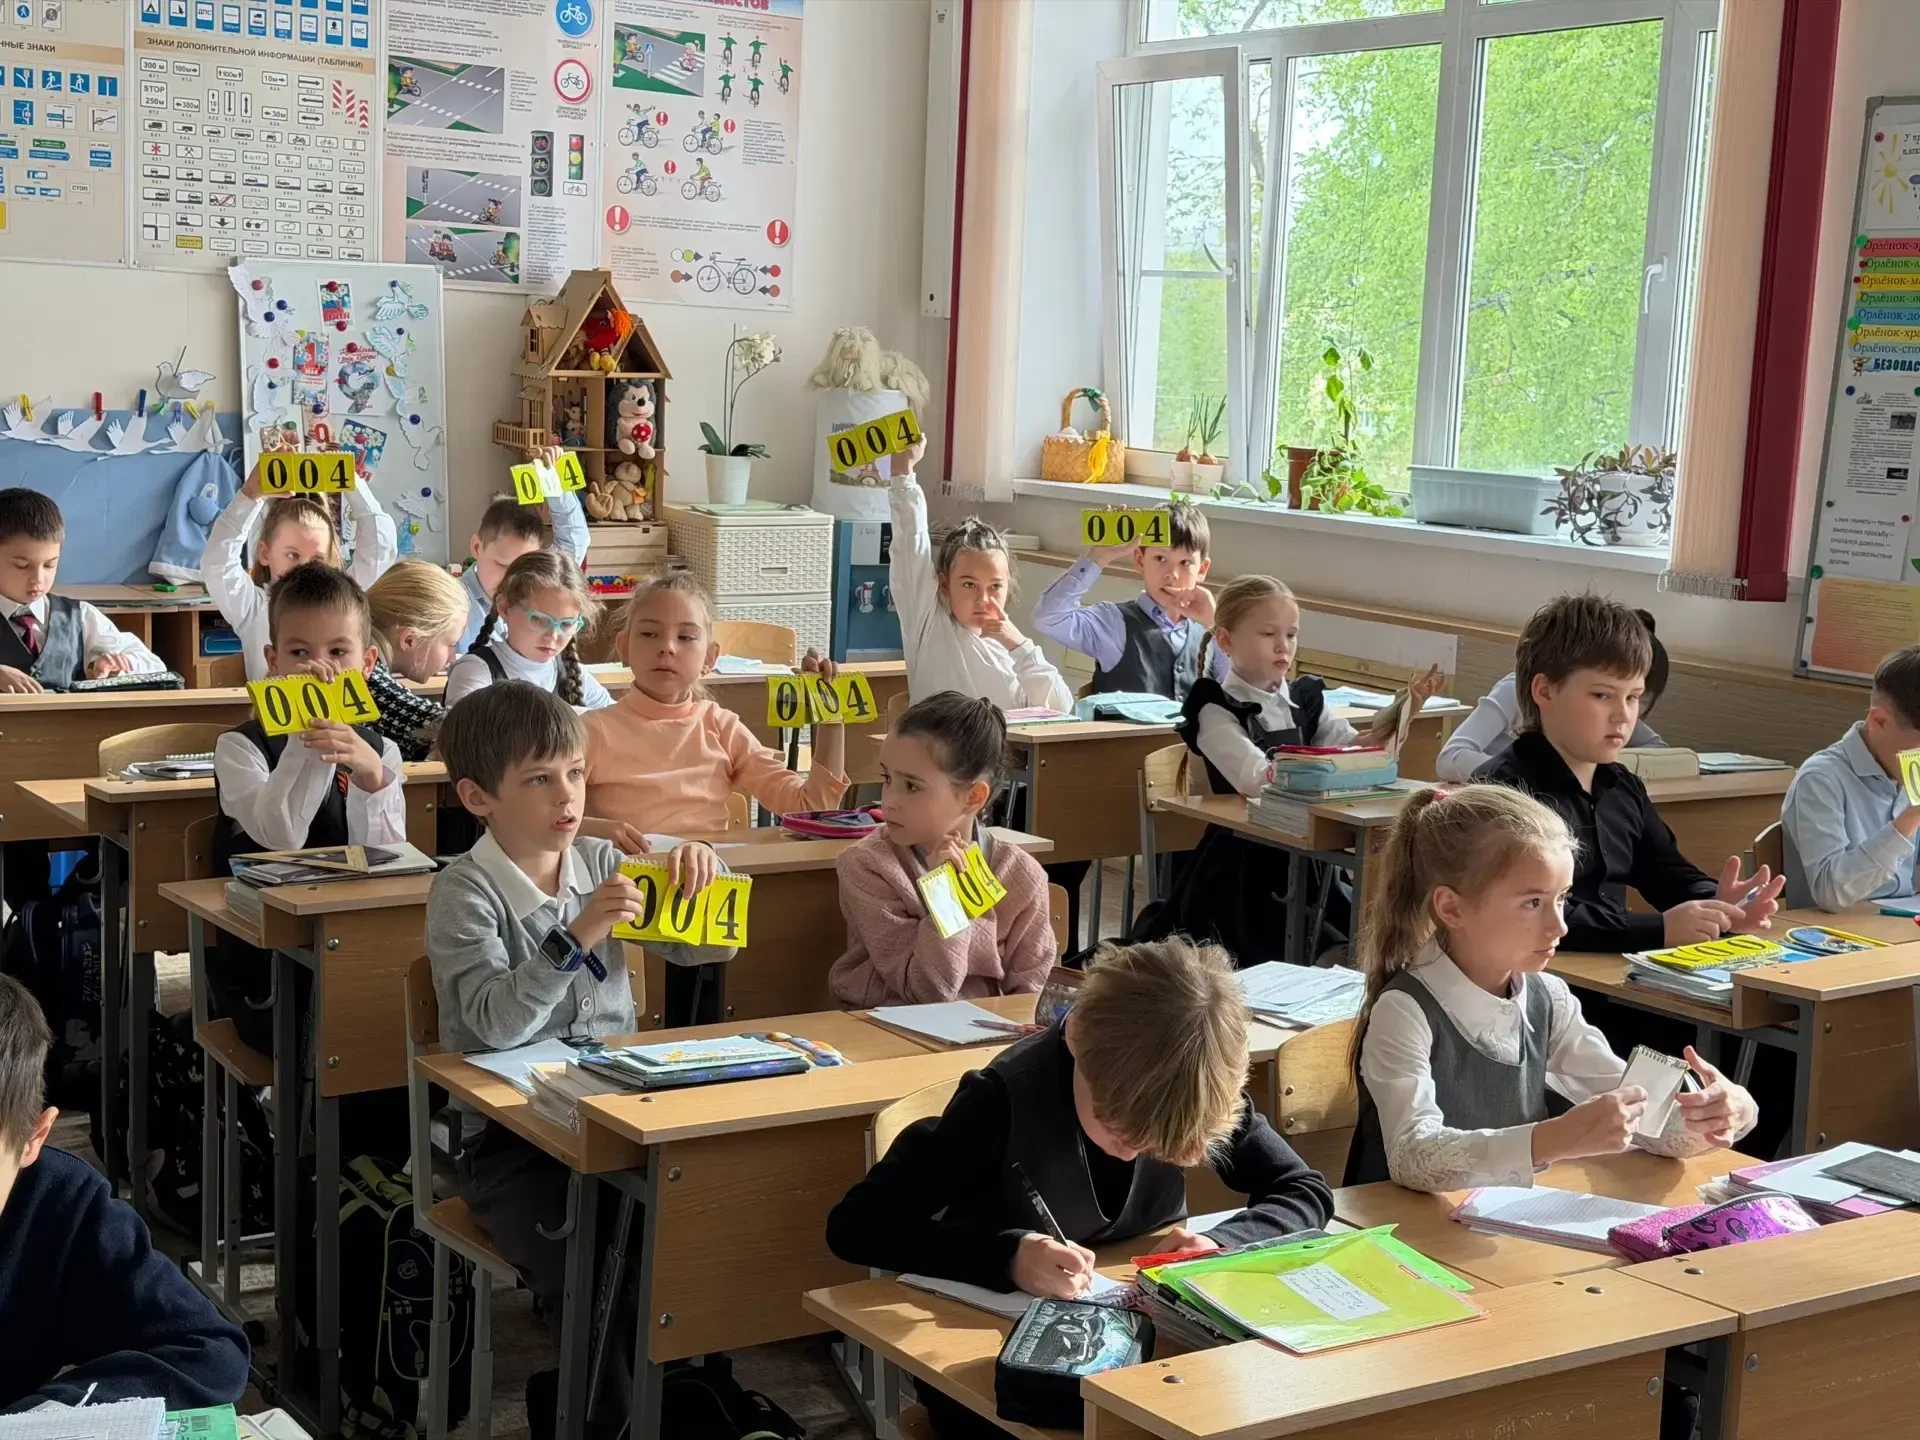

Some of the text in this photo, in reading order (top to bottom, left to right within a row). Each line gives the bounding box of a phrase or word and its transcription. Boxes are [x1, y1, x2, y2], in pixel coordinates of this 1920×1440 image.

[26, 43, 56, 53] ЗНАКИ
[147, 37, 364, 70] ЗНАКИ ДОПОЛНИТЕЛЬНОЙ ИНФОРМАЦИИ (ТАБЛИЧКИ)
[143, 61, 157, 70] 300
[143, 84, 165, 93] STOP
[145, 97, 165, 106] 250м
[72, 184, 88, 192] СТОП
[278, 201, 287, 209] 30
[344, 206, 354, 215] 15
[836, 416, 917, 467] 004
[267, 458, 351, 489] 004
[1087, 514, 1165, 543] 004
[264, 677, 372, 727] 004
[776, 678, 871, 721] 004
[628, 874, 740, 941] 004
